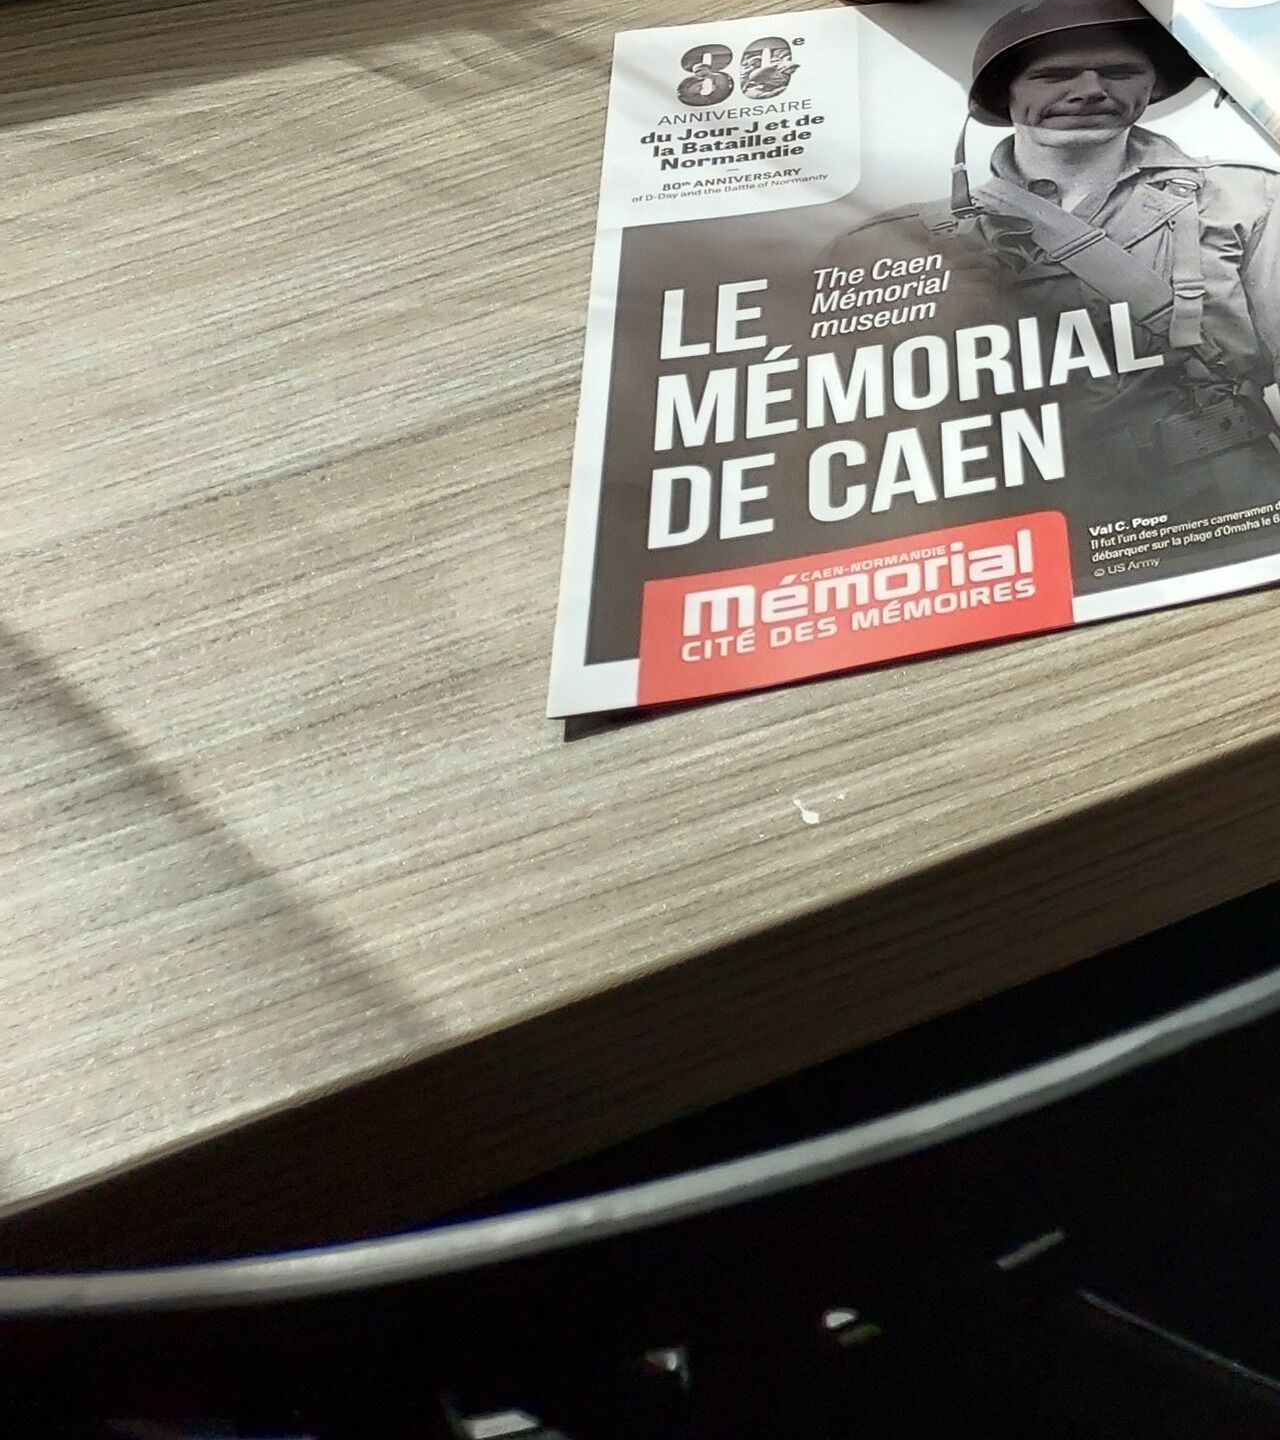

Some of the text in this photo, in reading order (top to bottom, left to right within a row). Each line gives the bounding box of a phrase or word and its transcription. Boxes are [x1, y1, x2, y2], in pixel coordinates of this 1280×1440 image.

[640, 114, 825, 145] du Jour J et de
[657, 98, 813, 126] ANNIVERSAIRE
[652, 129, 812, 157] la Bataille de
[660, 144, 805, 171] Normandie
[631, 172, 829, 203] of D-Day and the Battle of Normandy
[692, 167, 802, 187] ANNIVERSARY
[812, 252, 943, 291] The Caen
[810, 271, 950, 315] Mémorial
[659, 278, 769, 361] LE
[810, 301, 936, 340] museum
[653, 300, 1165, 452] MÉMORIAL
[646, 401, 1066, 550] DE CAEN
[1088, 513, 1168, 538] Val C. Pope
[1091, 543, 1150, 563] débarquer
[1151, 540, 1170, 552] sur
[1171, 535, 1182, 547] la
[1183, 530, 1213, 546] plage
[1261, 515, 1271, 528] le
[1272, 513, 1280, 525] 6
[1100, 536, 1116, 549] fut
[1138, 528, 1158, 541] des
[1159, 517, 1209, 538] premiers
[682, 528, 1035, 638] mémorial
[799, 544, 948, 583] CAEN-NORMANDIE
[1107, 562, 1127, 575] US
[1127, 557, 1161, 572] Army
[681, 577, 1037, 663] CITÉ DES MÉMOIRES
